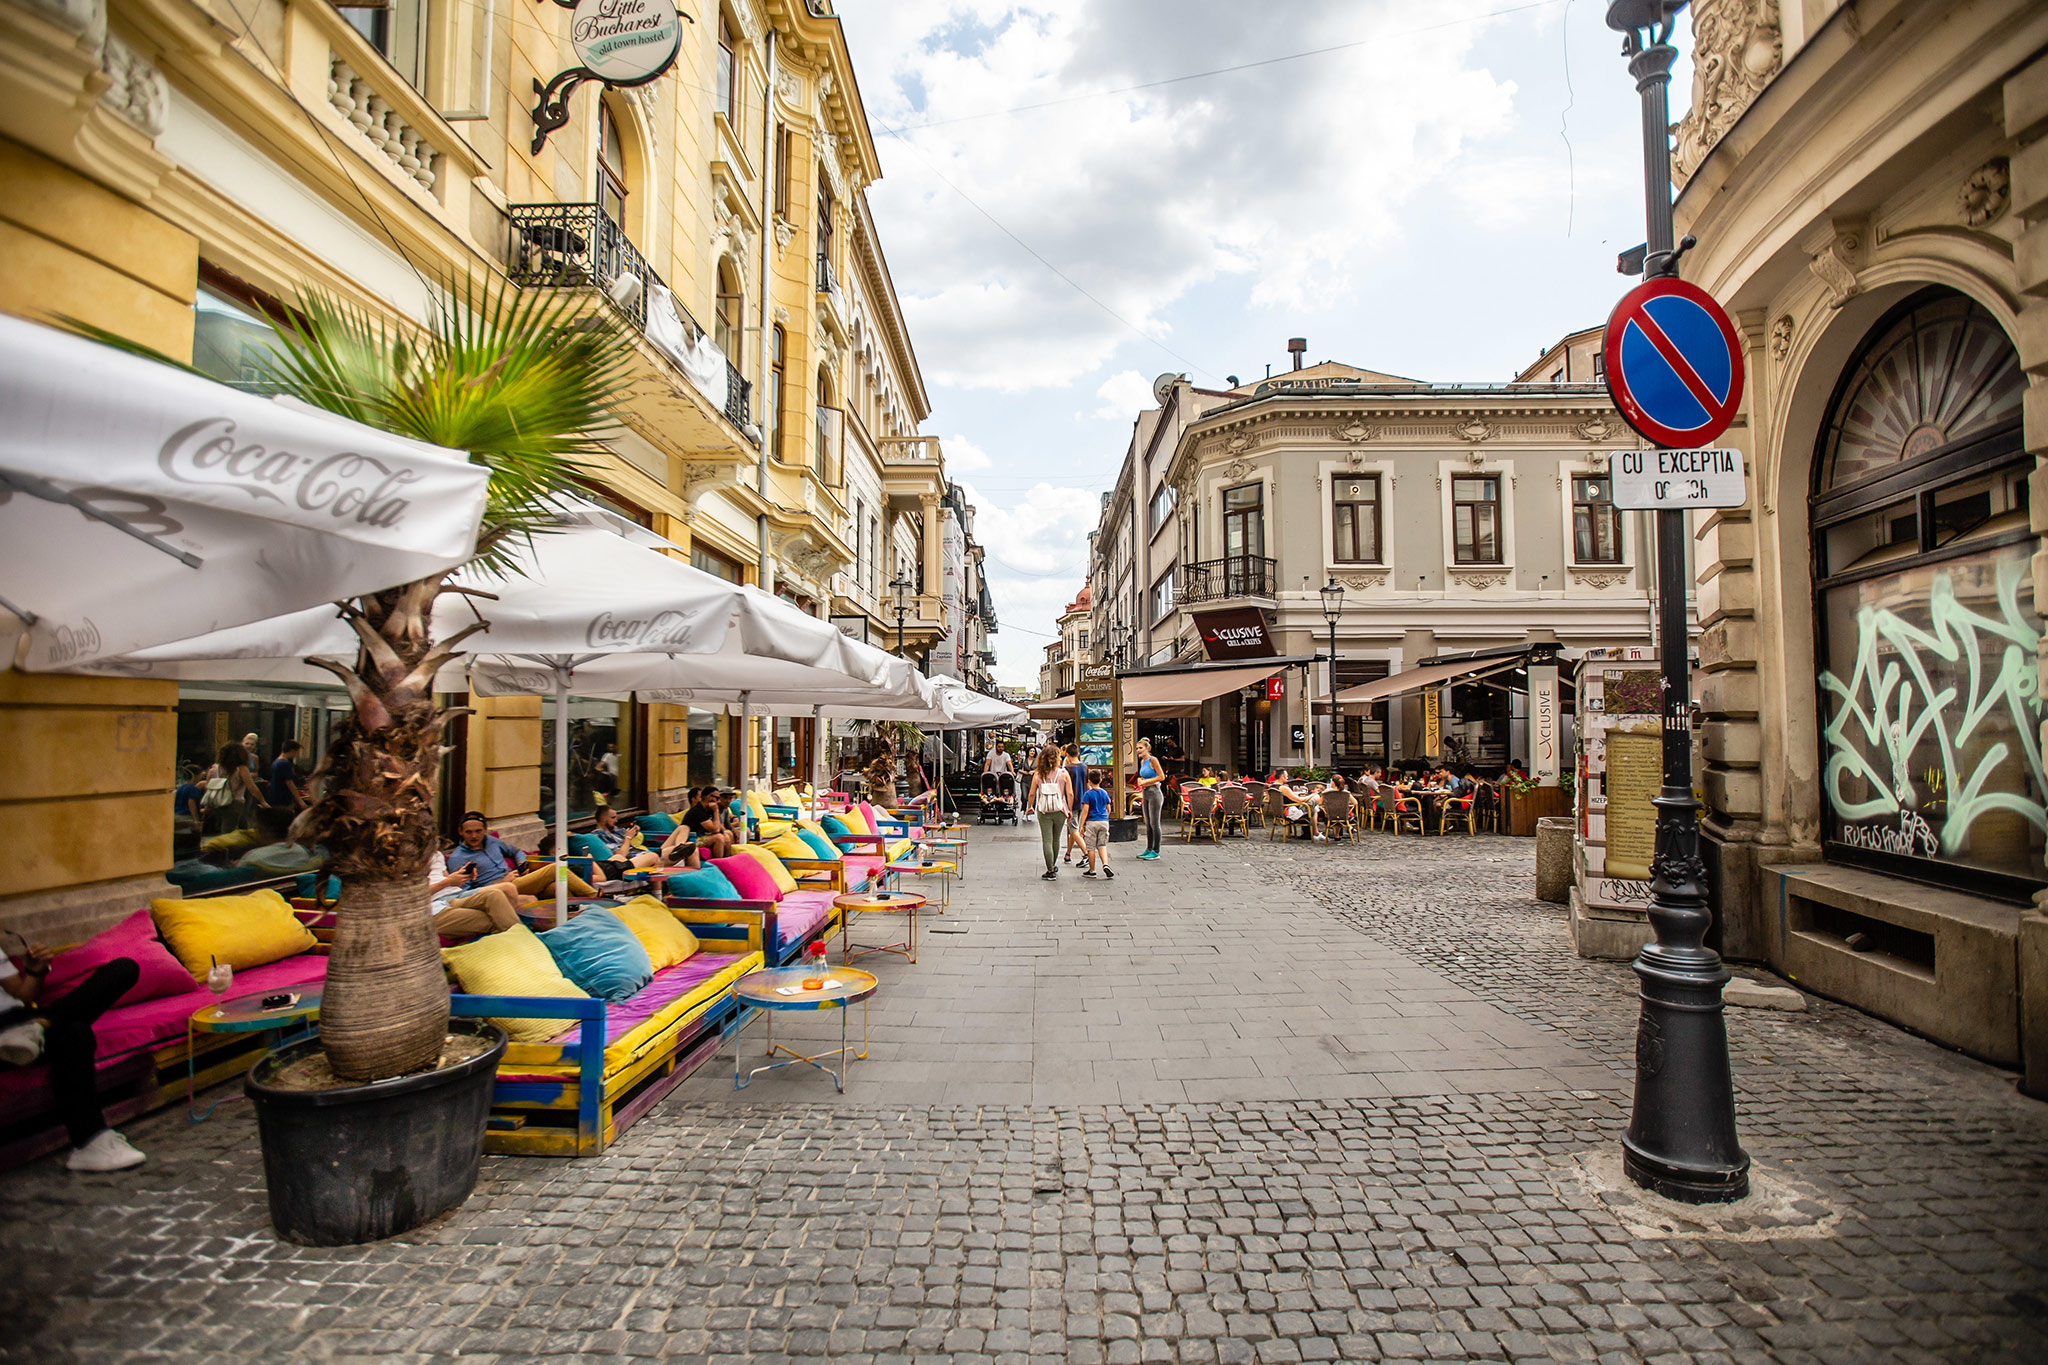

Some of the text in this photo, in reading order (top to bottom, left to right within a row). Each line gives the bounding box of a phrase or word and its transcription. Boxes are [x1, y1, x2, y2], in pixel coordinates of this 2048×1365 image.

[599, 0, 646, 18] Little
[574, 13, 662, 42] Bucharest
[599, 31, 665, 56] old town hostel
[158, 416, 425, 529] Coca-Cola
[1622, 452, 1643, 474] CU
[1428, 694, 1438, 748] XCLUSIVE
[1539, 690, 1552, 760] XCLUSIVE
